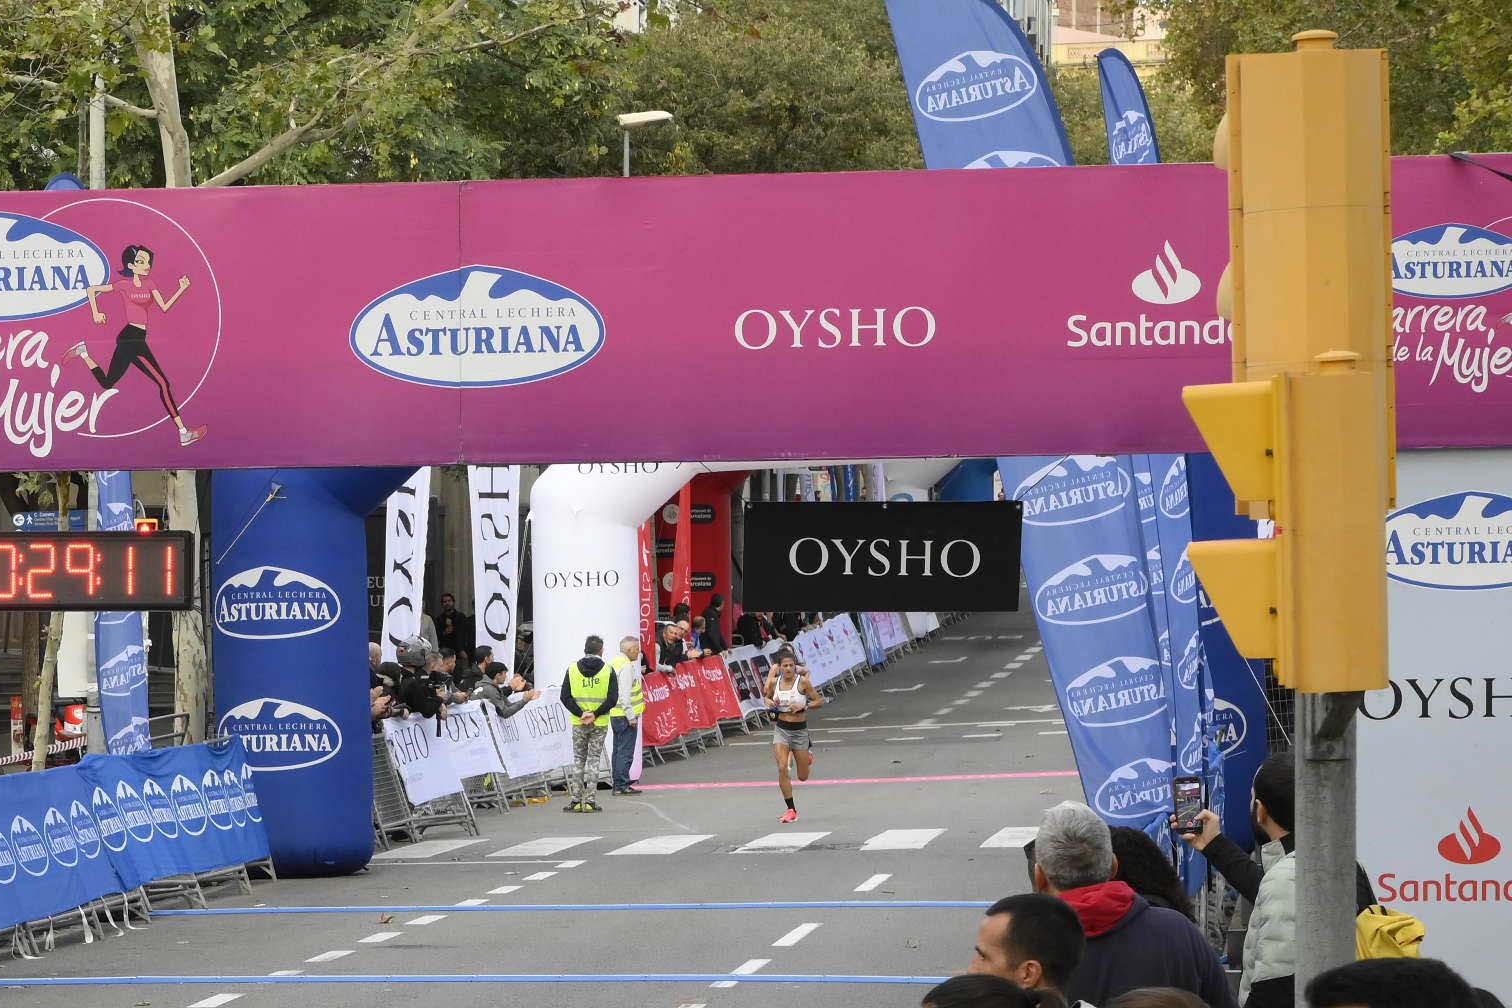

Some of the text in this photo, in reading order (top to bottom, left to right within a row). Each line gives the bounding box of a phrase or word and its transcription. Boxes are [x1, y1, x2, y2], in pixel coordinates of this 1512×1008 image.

[12, 248, 85, 259] LECHERA
[409, 307, 576, 321] CENTRAL LECHERA
[1394, 304, 1488, 333] arrera
[370, 312, 585, 357] ASTURIANA
[734, 306, 936, 350] OYSHO
[1416, 334, 1433, 361] la
[1413, 526, 1480, 536] CENTRAL
[789, 537, 980, 577] OYSHO
[544, 570, 620, 590] OYSHO
[231, 591, 274, 599] CENTRAL
[219, 595, 331, 624] ASTURIANA
[279, 722, 327, 730] LECHERA
[524, 702, 567, 739] OYSHO
